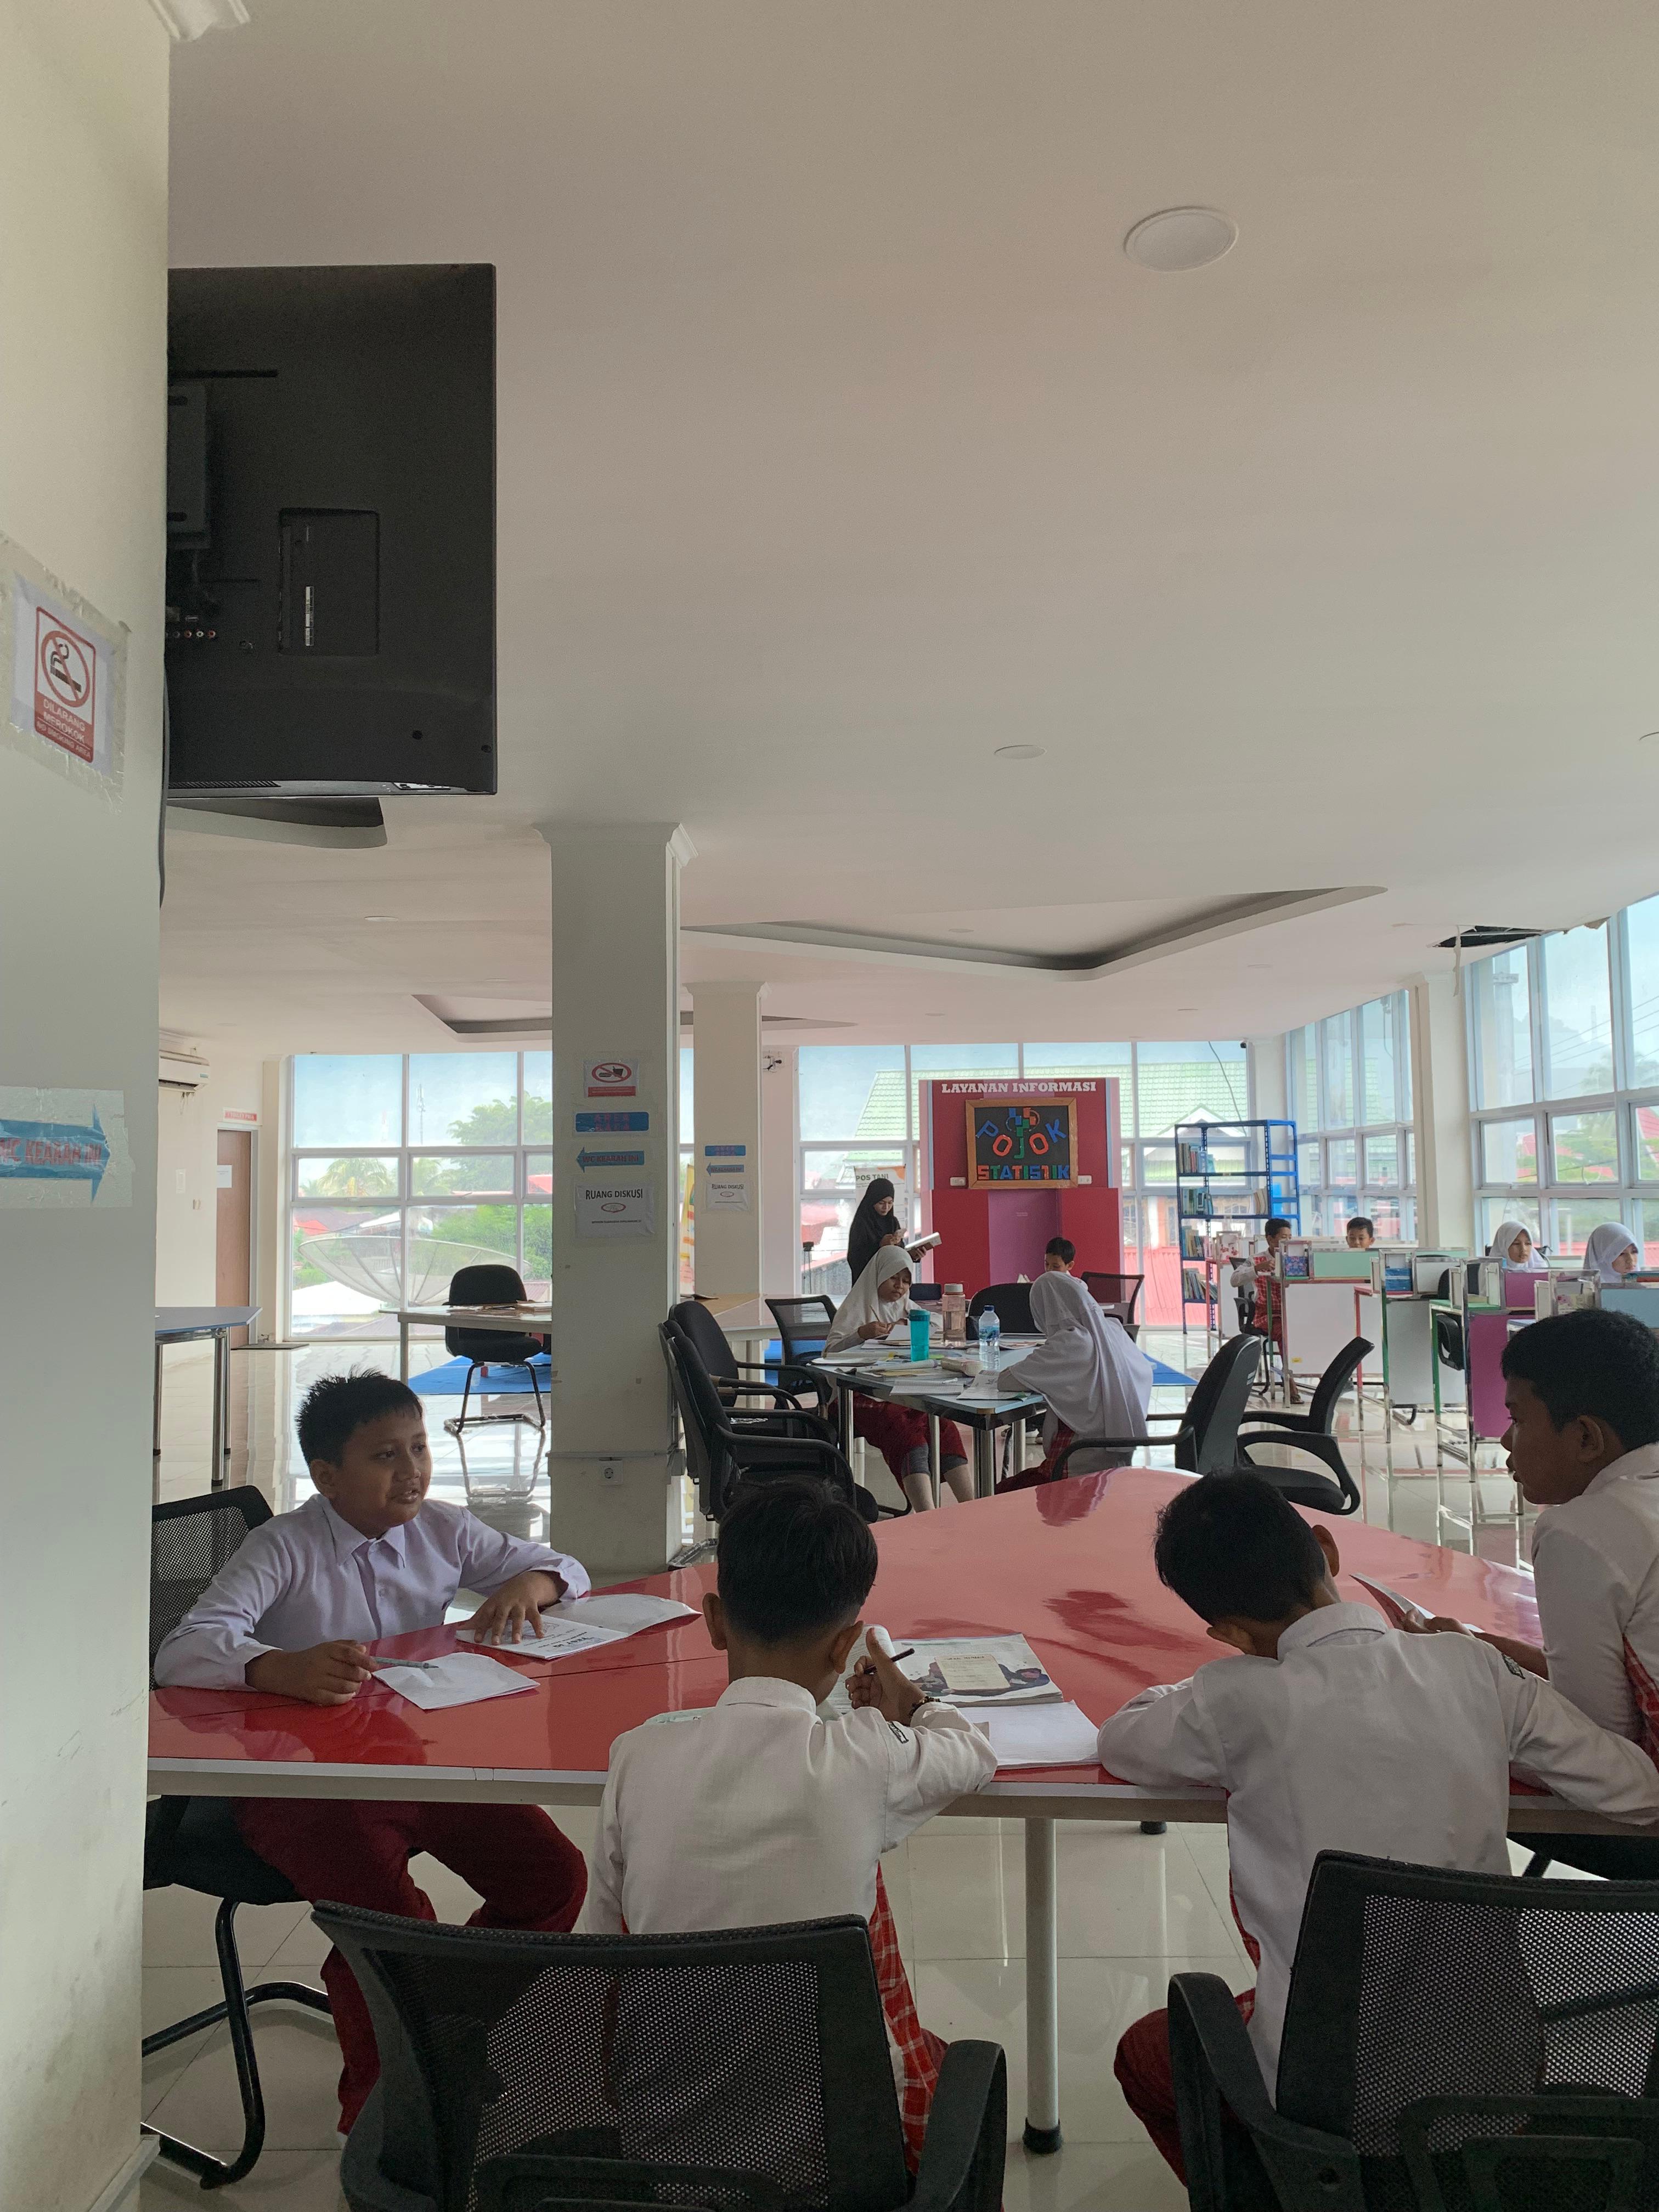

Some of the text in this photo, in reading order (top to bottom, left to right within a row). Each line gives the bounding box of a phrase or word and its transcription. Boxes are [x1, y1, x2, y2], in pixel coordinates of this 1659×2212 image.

[43, 698, 86, 731] DILARANG
[43, 711, 85, 744] MEROKOK
[941, 1081, 1097, 1093] LAYANAN INFORMASI
[975, 1119, 1067, 1159] POJOK
[977, 1165, 1069, 1180] STATISTIK
[585, 1188, 643, 1200] RUANG DISKUSI
